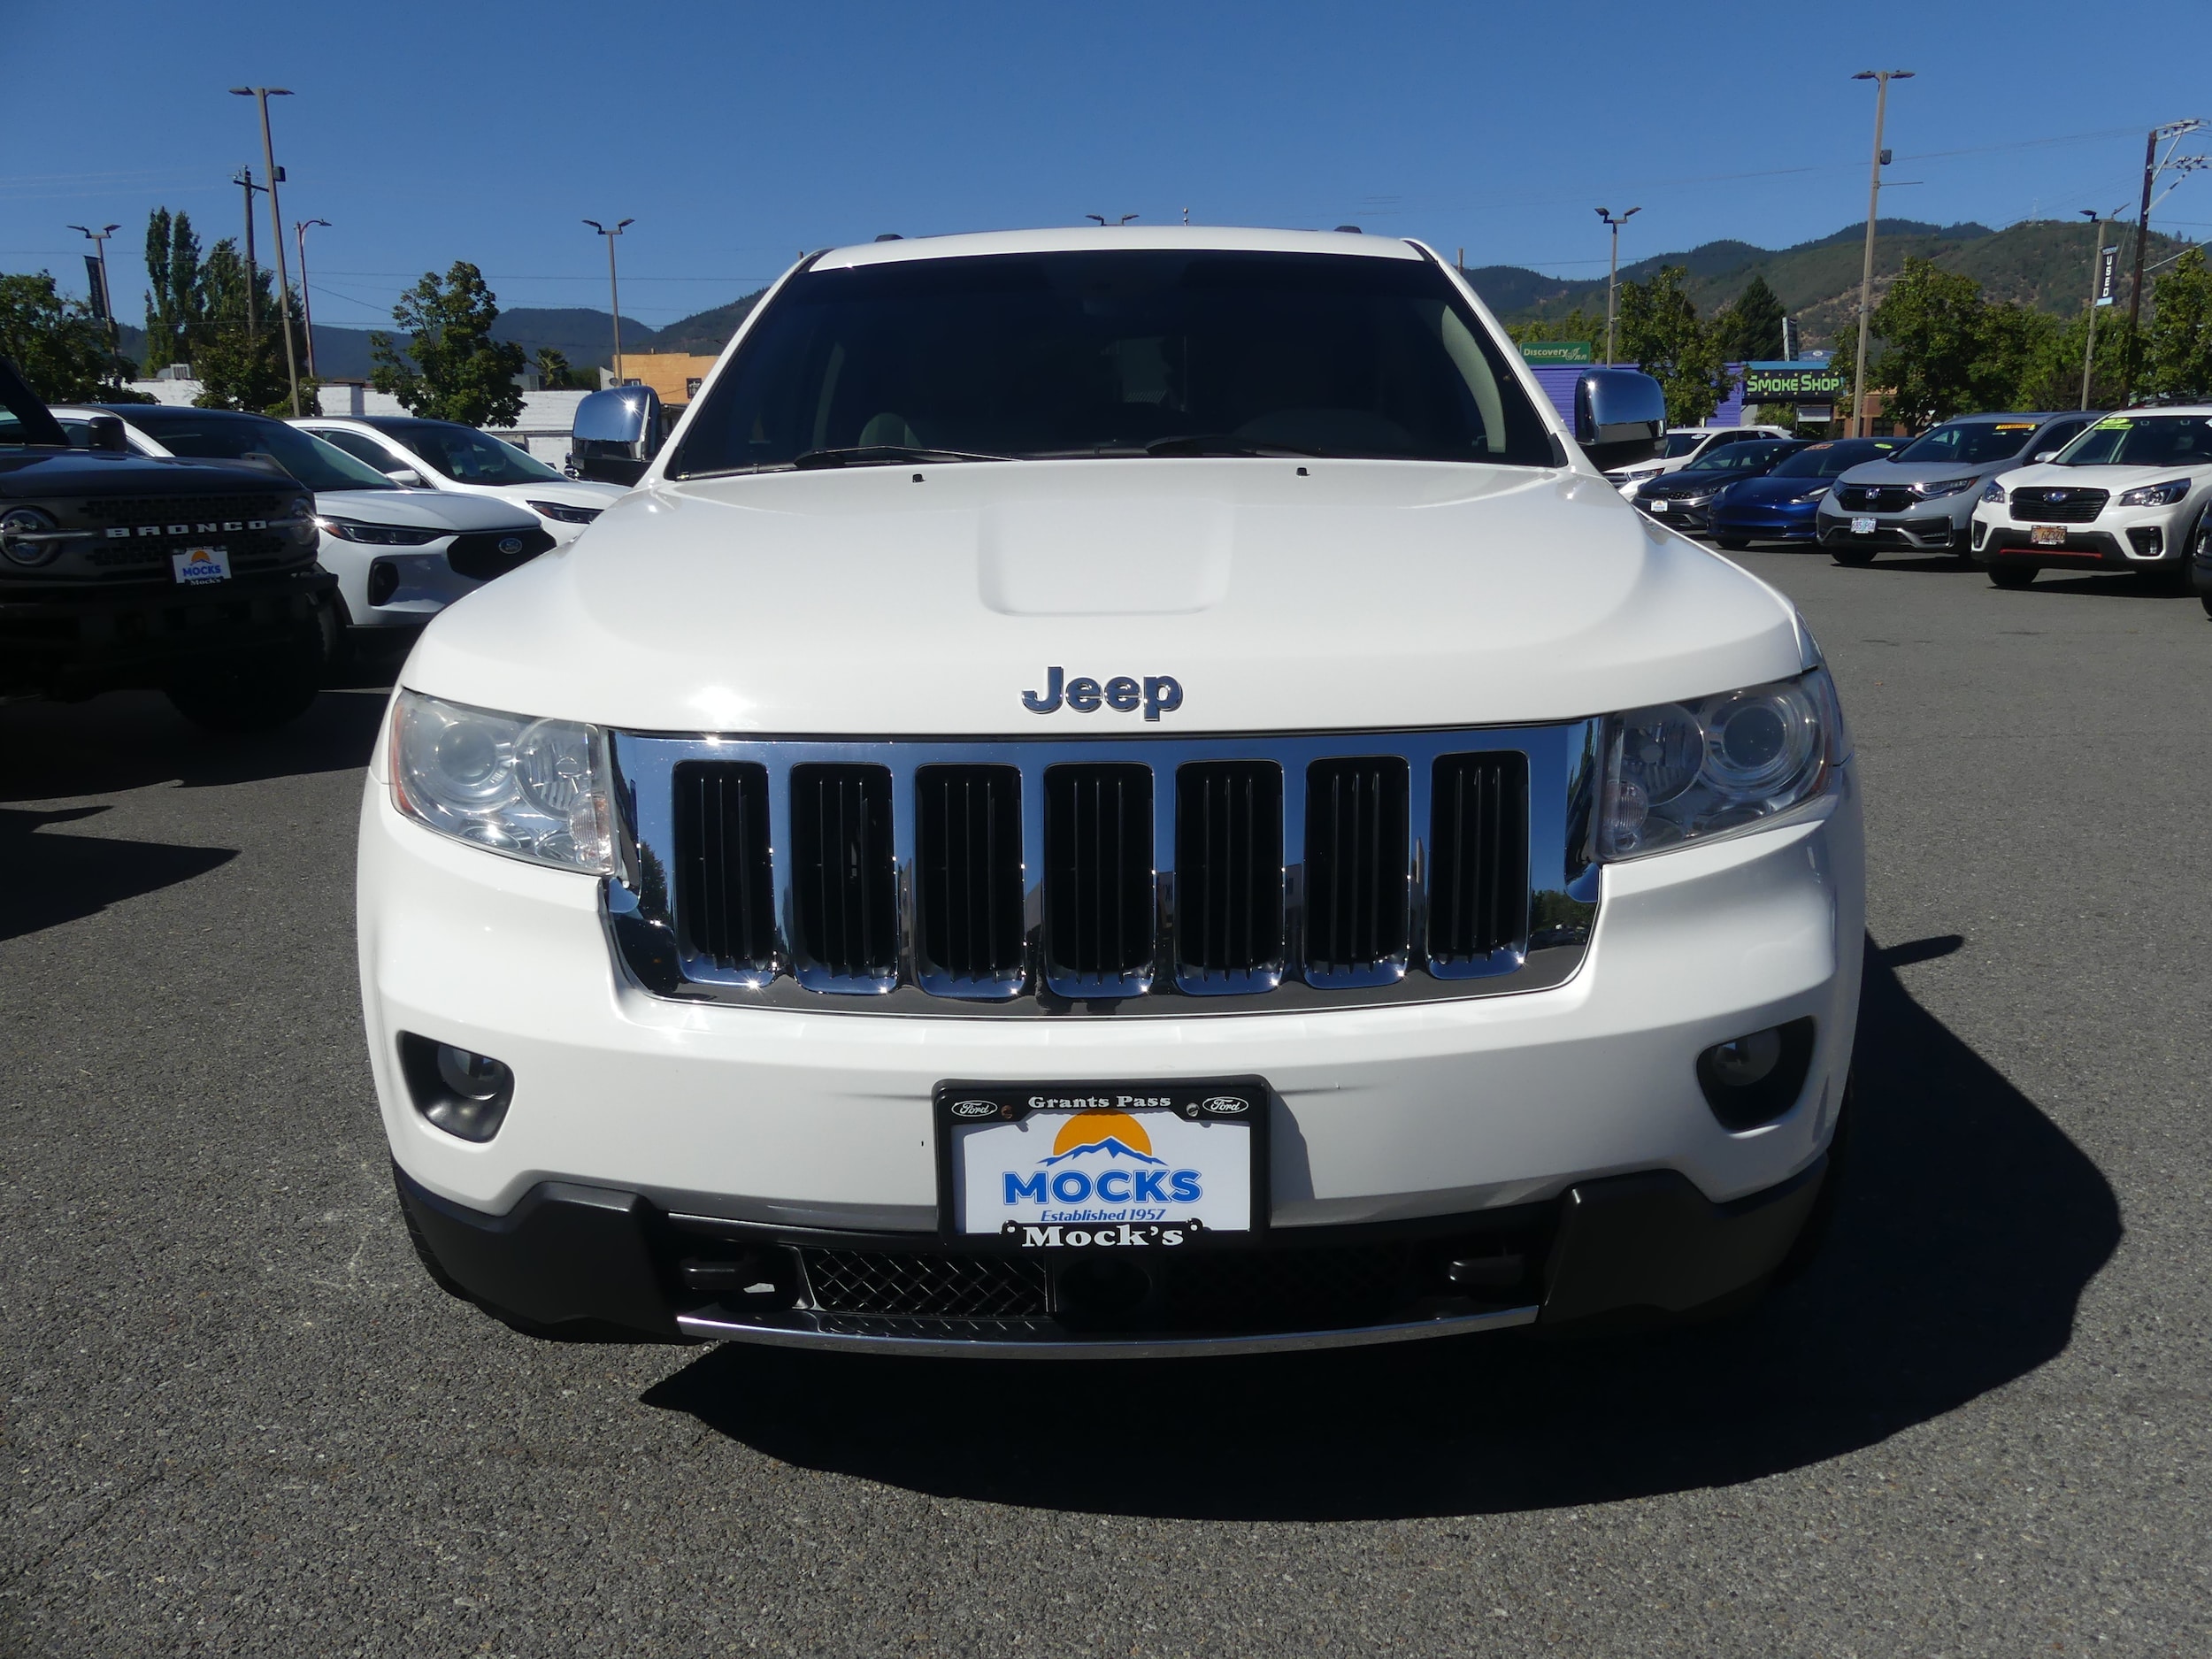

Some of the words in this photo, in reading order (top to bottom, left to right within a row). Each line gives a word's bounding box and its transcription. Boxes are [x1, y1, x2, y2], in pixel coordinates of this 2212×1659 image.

[2102, 256, 2113, 297] USED
[1524, 348, 1568, 357] Discovery
[1564, 347, 1587, 361] Inn
[1747, 375, 1799, 392] SMOKE
[1801, 374, 1839, 391] SHOP
[106, 520, 267, 538] BRONCO
[182, 565, 221, 577] MOCKS
[1021, 666, 1184, 722] Jeep
[958, 1102, 991, 1115] Ford
[1028, 1096, 1110, 1108] Grants
[1117, 1096, 1171, 1107] Pass
[1210, 1098, 1240, 1111] Ford
[1002, 1169, 1202, 1205] MOCKS
[1041, 1209, 1126, 1222] Established
[1130, 1209, 1166, 1221] 1957
[1022, 1224, 1184, 1248] Mock's
